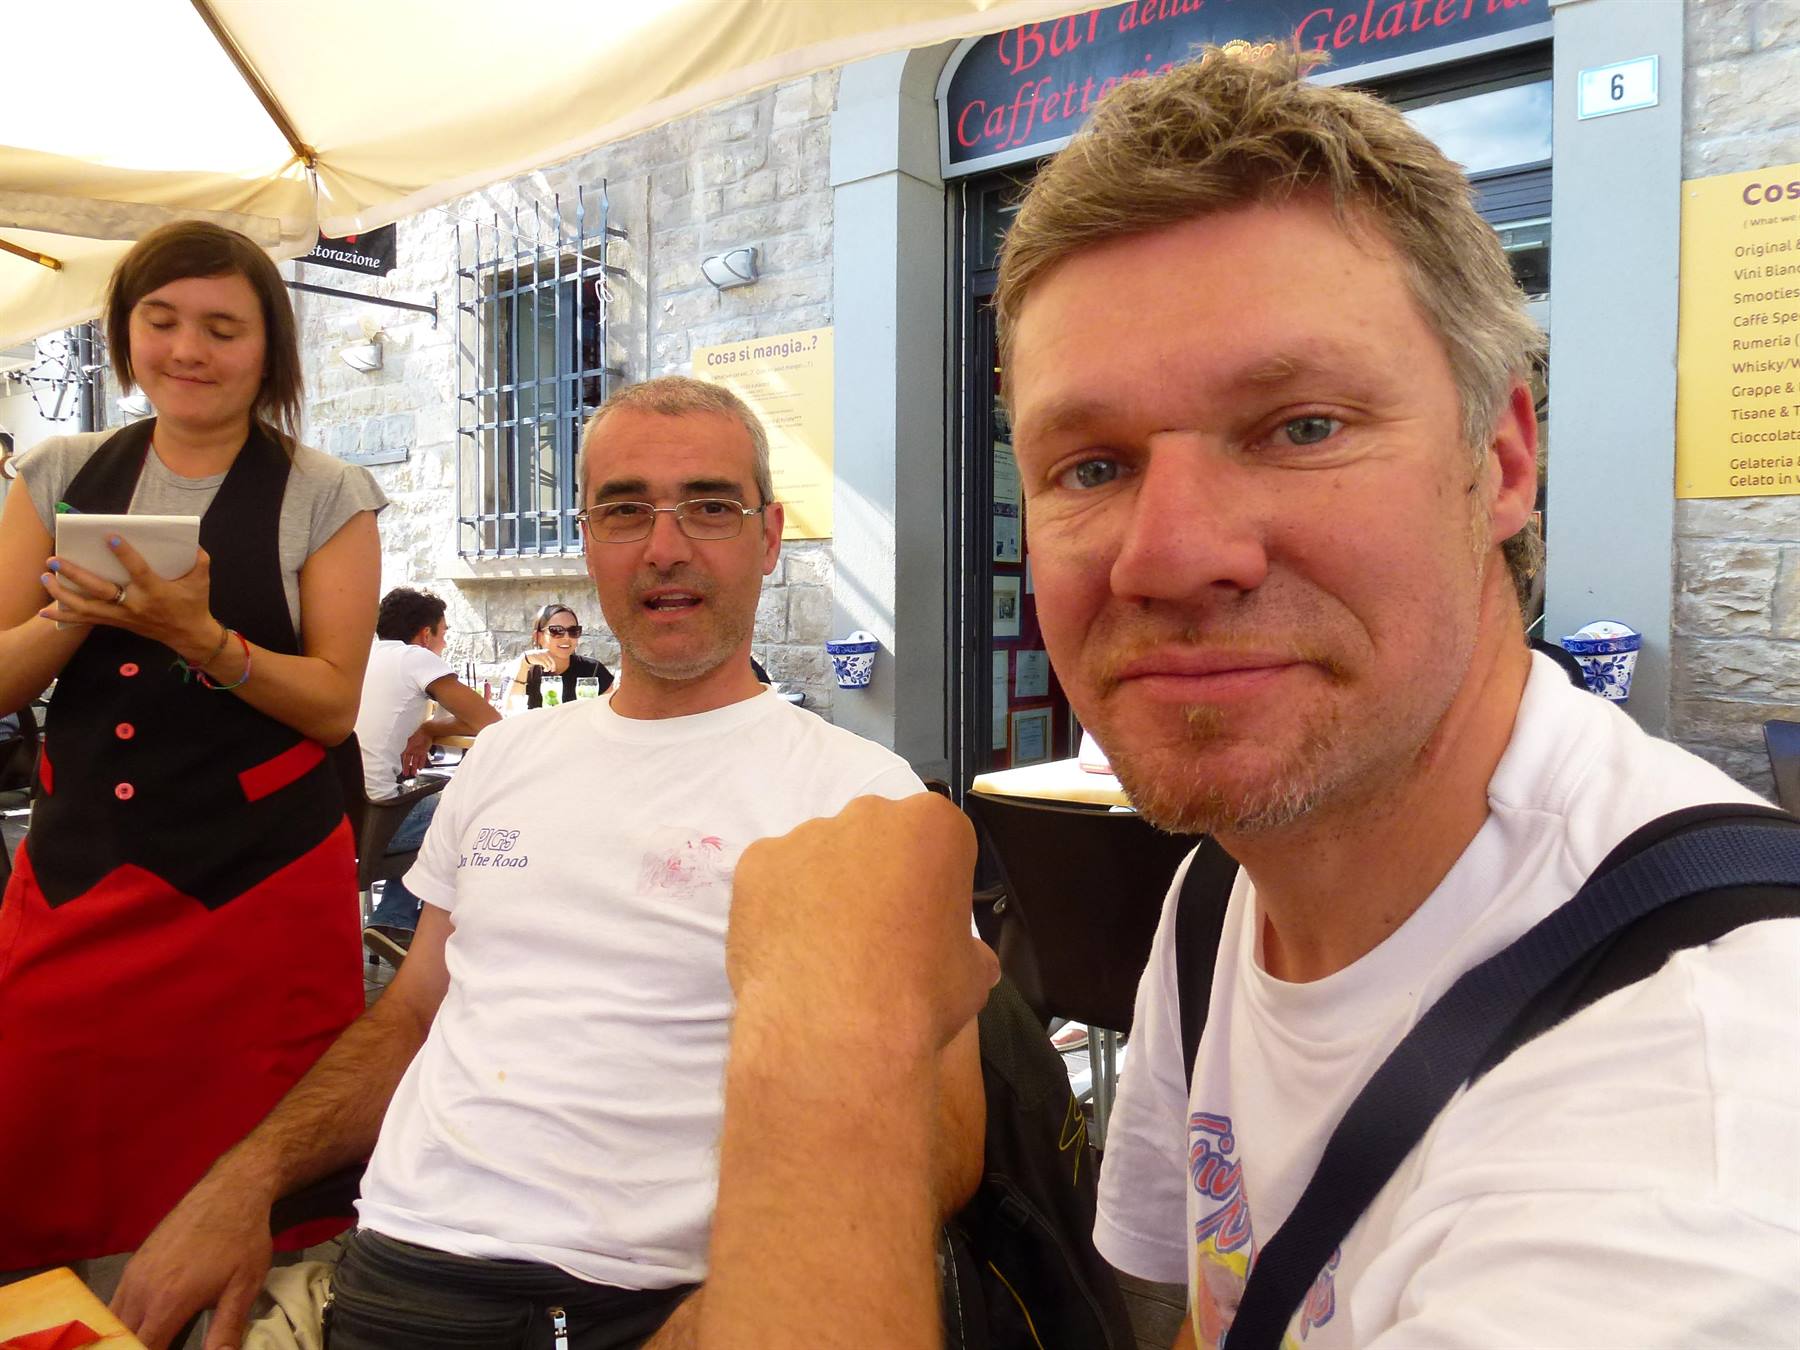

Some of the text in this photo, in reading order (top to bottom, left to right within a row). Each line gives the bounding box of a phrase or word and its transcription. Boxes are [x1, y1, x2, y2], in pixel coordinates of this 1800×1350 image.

[998, 8, 1101, 76] Bar
[957, 0, 1531, 149] Caffette Gelater
[1611, 73, 1624, 101] 6
[1743, 181, 1800, 205] Cos
[1735, 240, 1792, 257] Original
[1734, 267, 1762, 280] Vini
[1734, 287, 1800, 304] Smooties
[1773, 312, 1800, 324] Spe
[707, 335, 818, 366] Cosa si mangia..?
[1733, 335, 1791, 350] Rumeria
[1732, 382, 1795, 397] Grappe &
[1731, 408, 1776, 420] Tisane
[1780, 406, 1789, 417] &
[1730, 456, 1793, 470] Gelateria
[1729, 475, 1775, 487] Gelato
[1779, 472, 1792, 484] in
[472, 828, 521, 851] PIGS
[470, 852, 490, 867] The
[491, 853, 528, 868] Road
